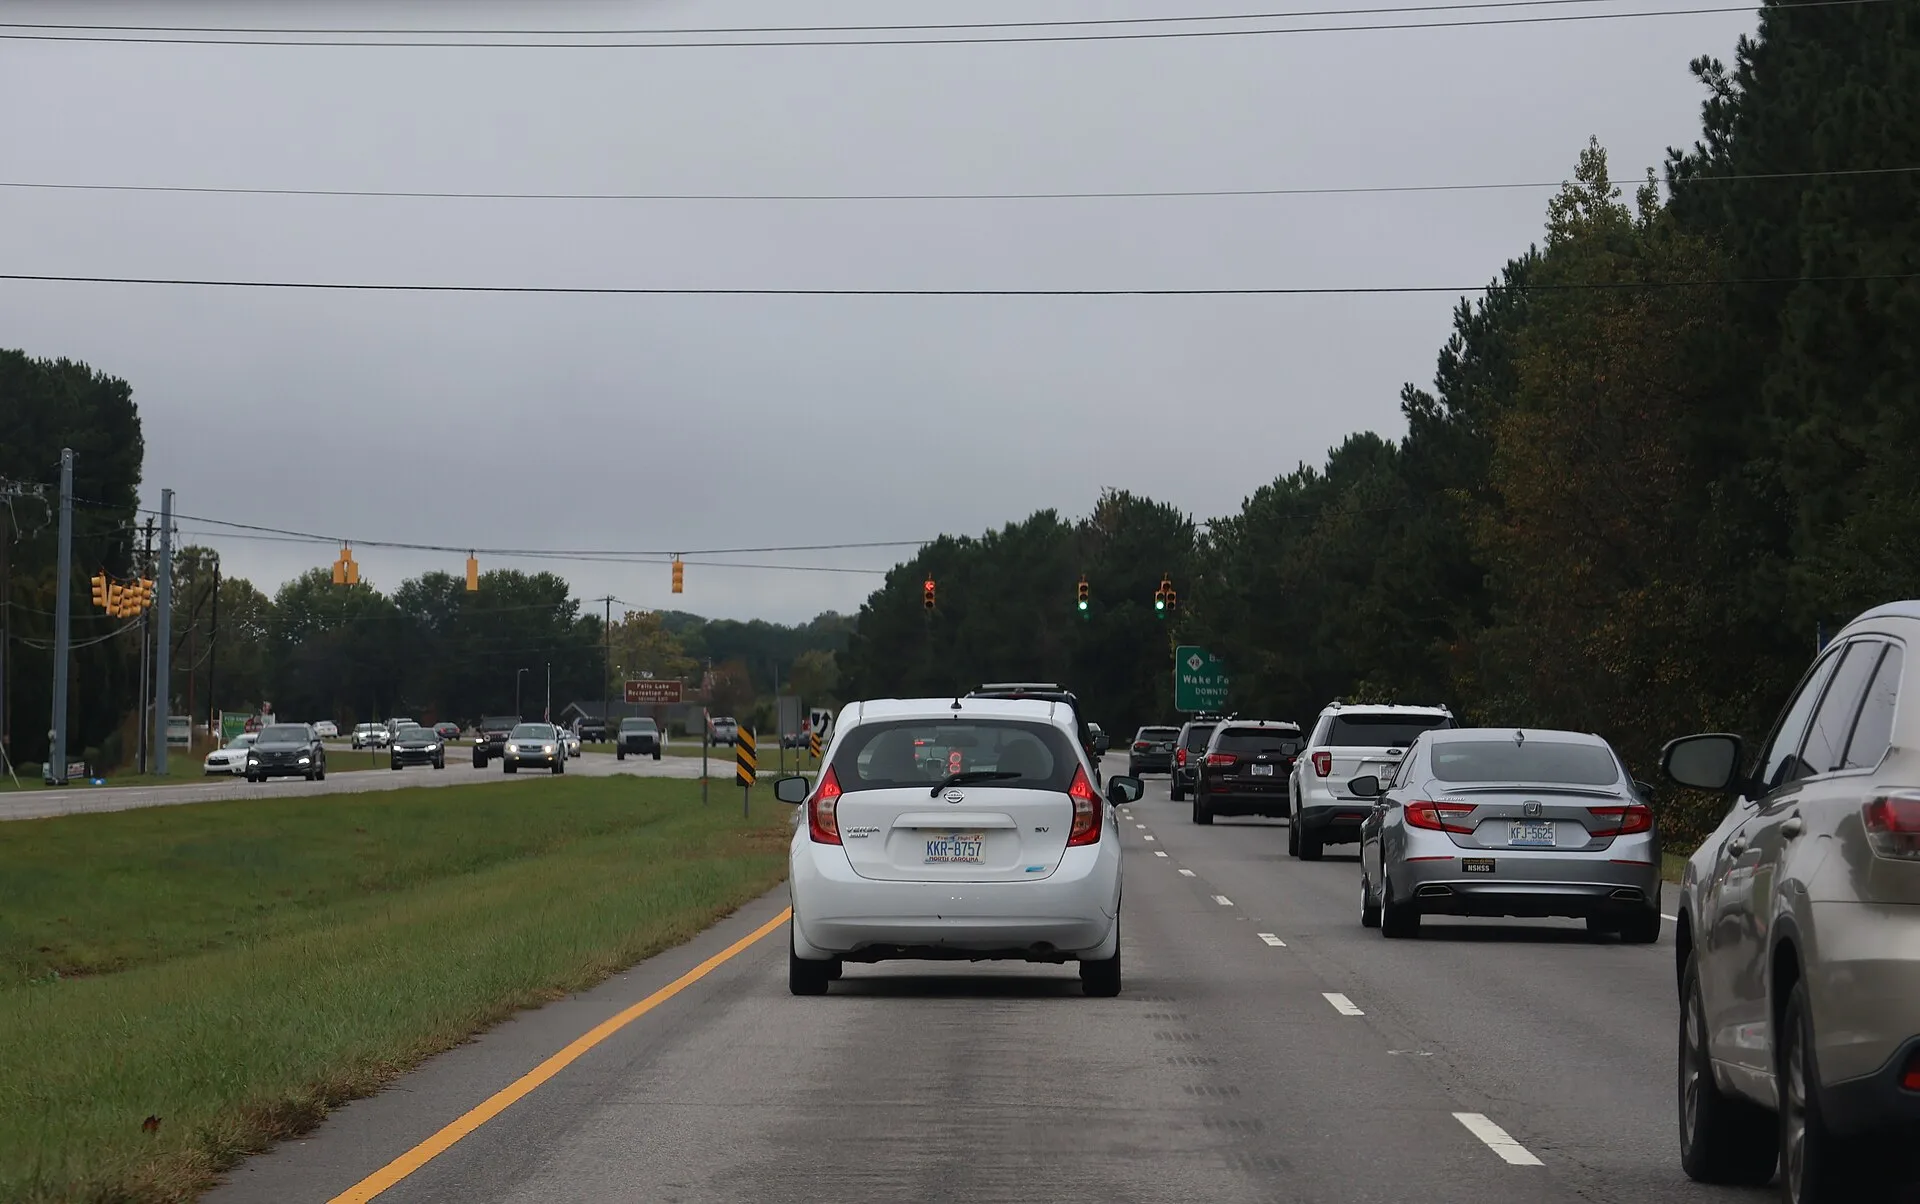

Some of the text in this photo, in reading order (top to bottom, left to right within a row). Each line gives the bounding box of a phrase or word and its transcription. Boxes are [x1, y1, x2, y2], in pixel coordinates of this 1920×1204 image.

[1183, 674, 1211, 684] Wake
[1195, 687, 1229, 696] DOWNTO
[1510, 827, 1554, 839] KFJ-5625
[926, 841, 982, 857] KKR-8757
